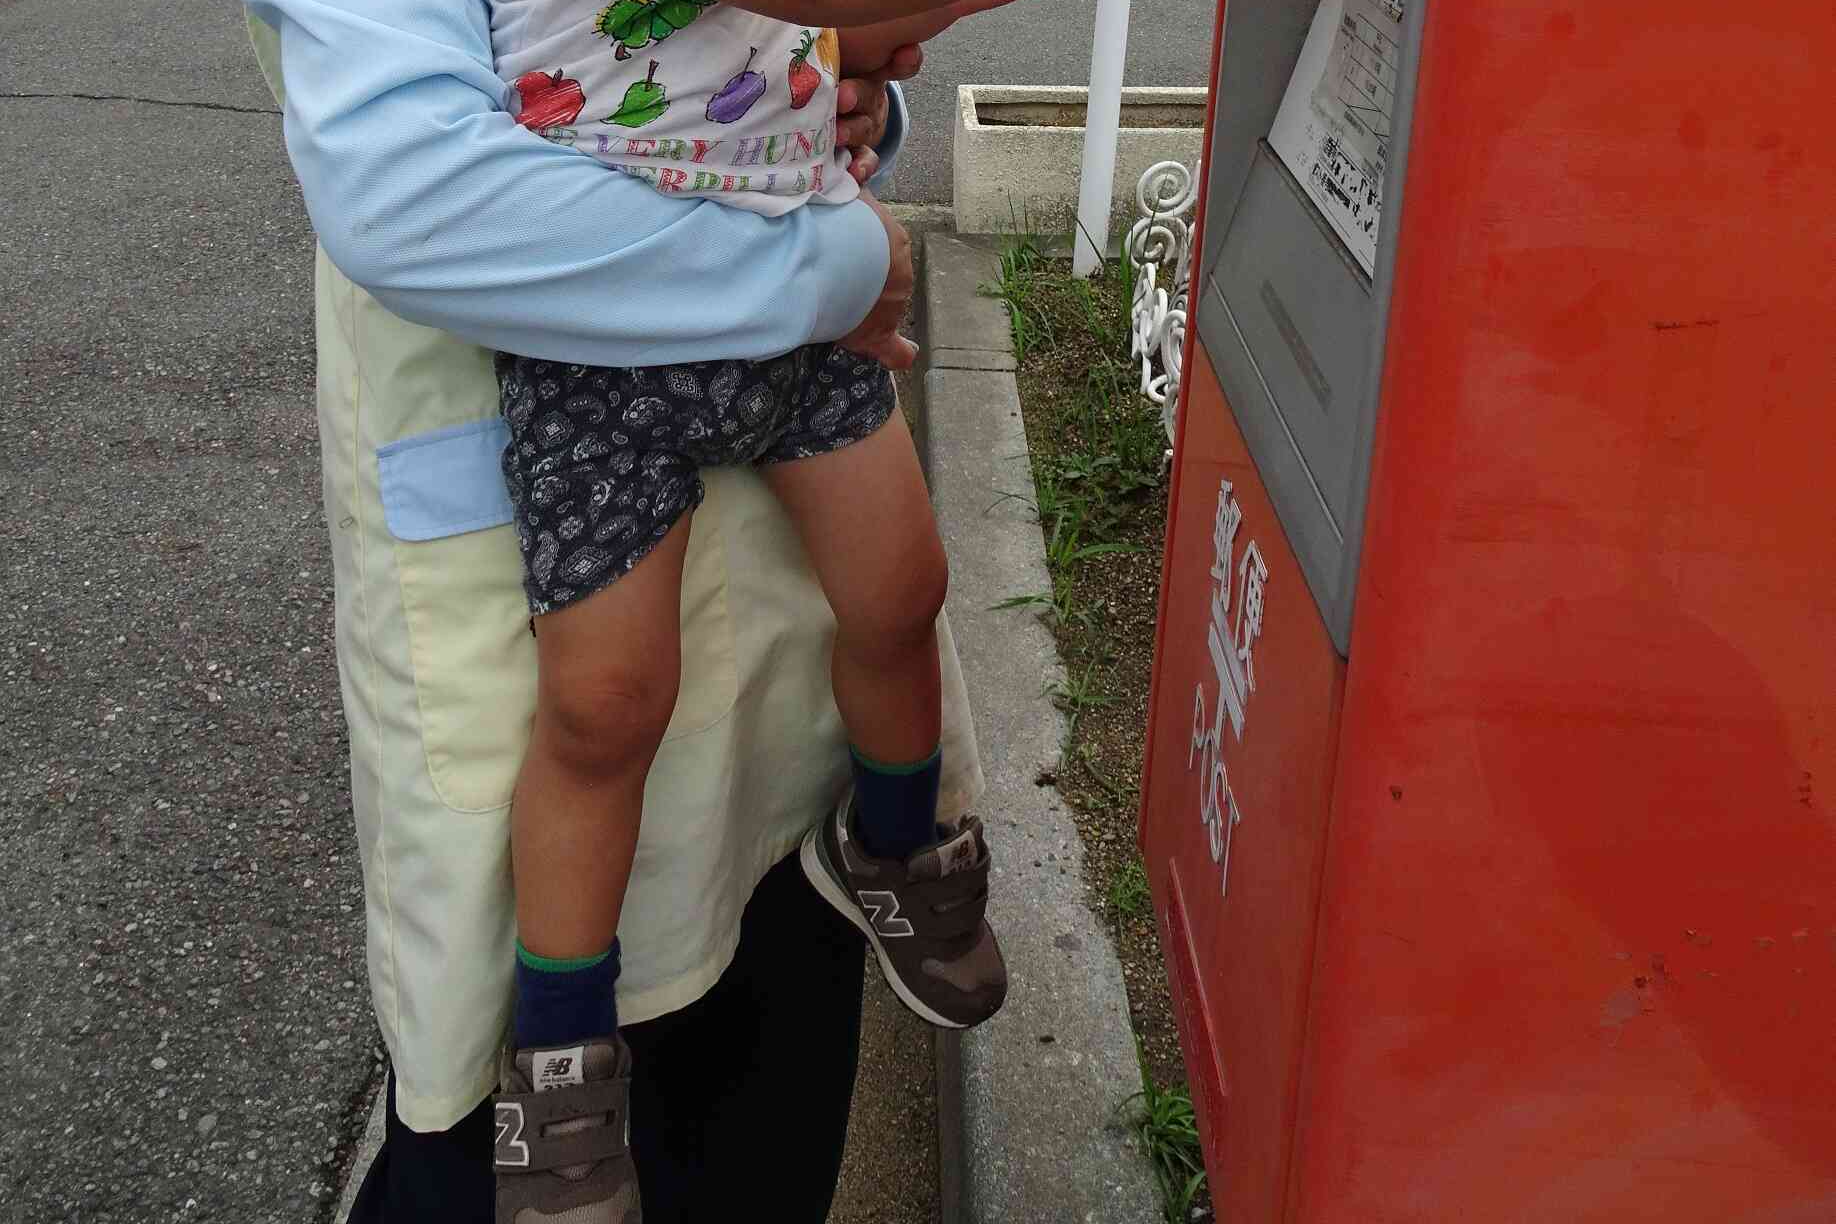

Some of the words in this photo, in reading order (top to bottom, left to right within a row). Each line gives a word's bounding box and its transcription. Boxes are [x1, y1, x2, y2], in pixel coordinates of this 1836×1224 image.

[594, 133, 729, 164] VERY
[728, 116, 836, 166] HUNG
[1209, 478, 1269, 694] 郵便
[1188, 682, 1242, 897] POST
